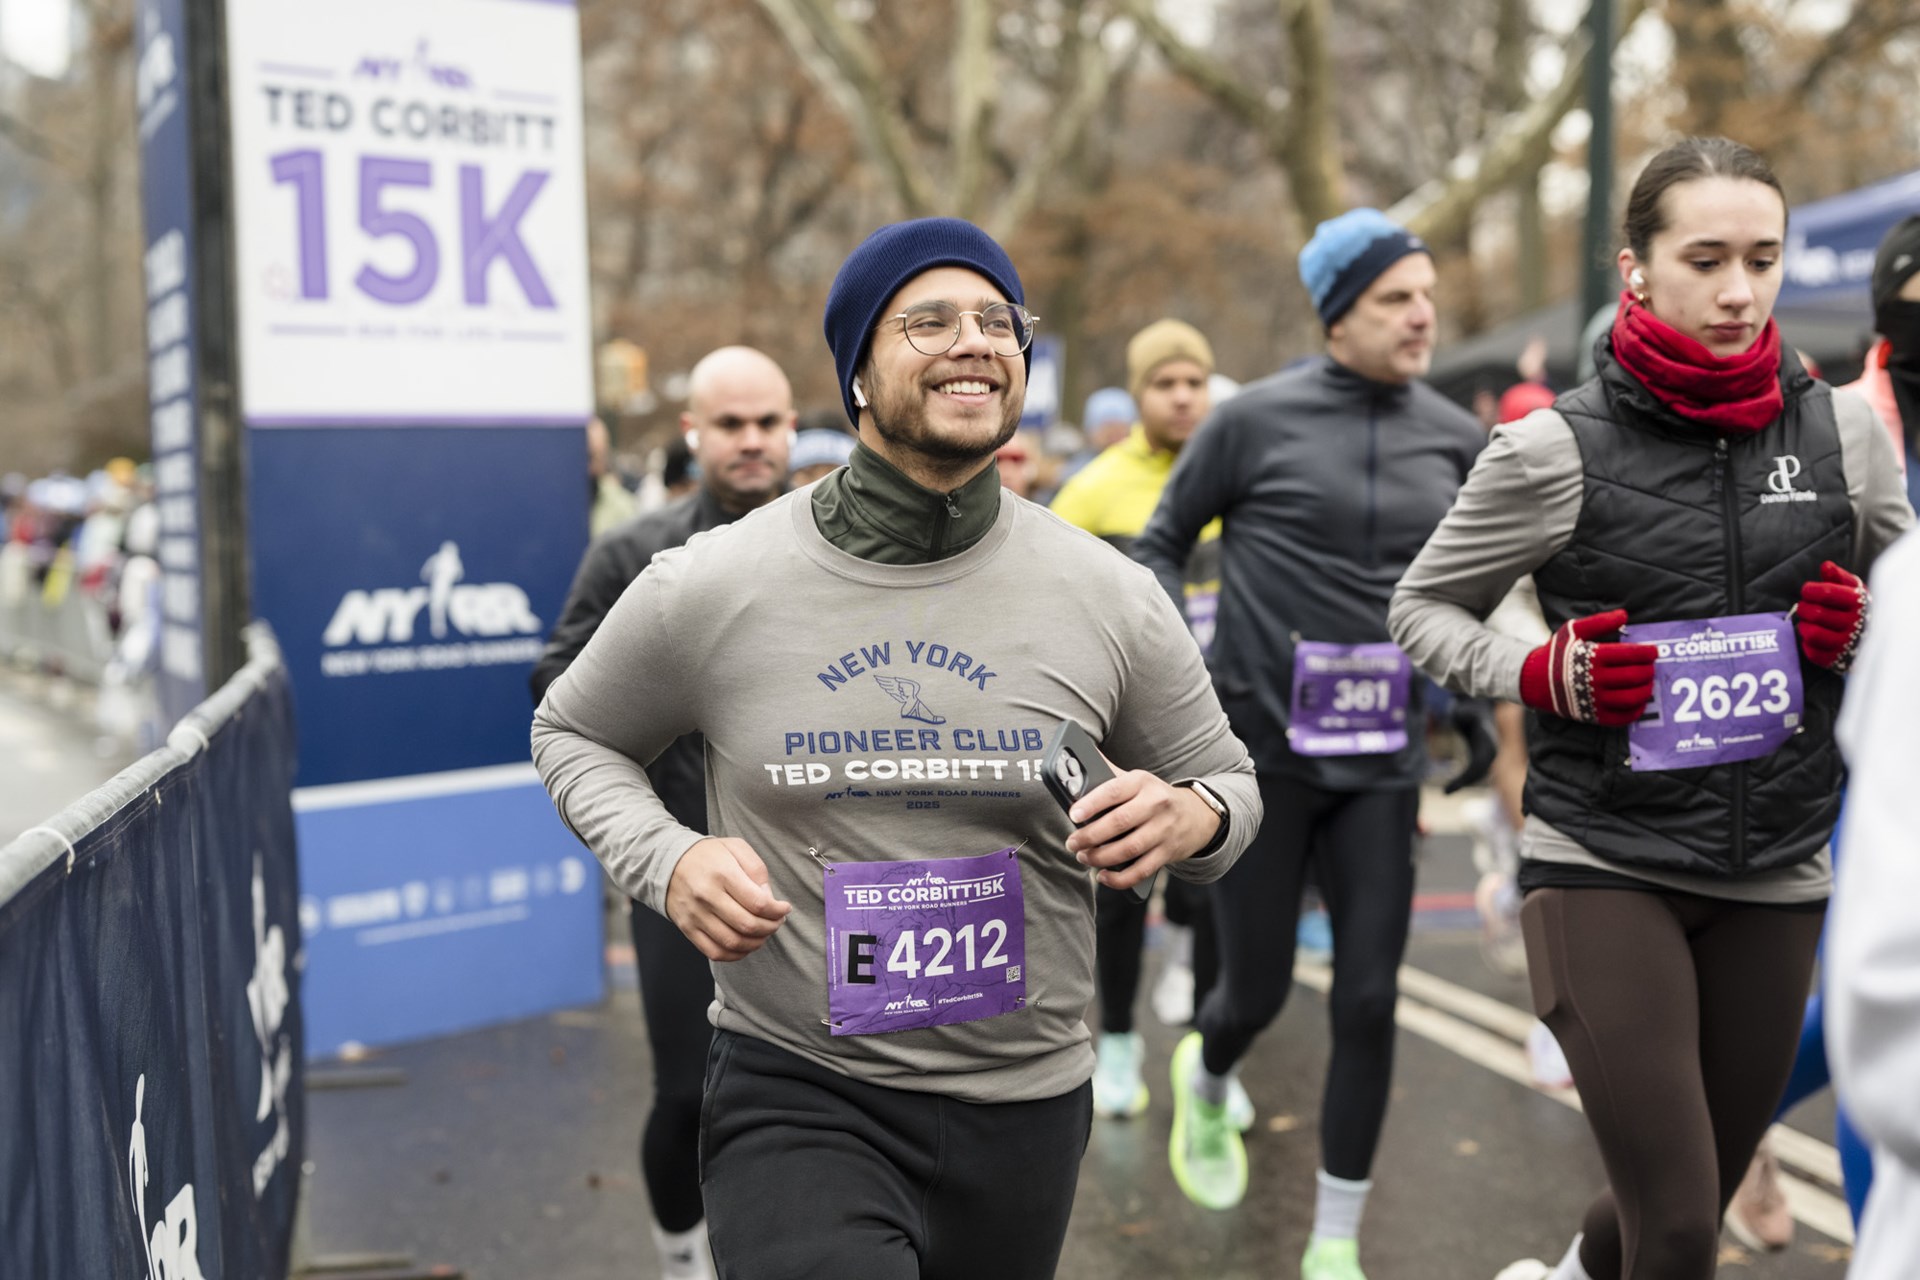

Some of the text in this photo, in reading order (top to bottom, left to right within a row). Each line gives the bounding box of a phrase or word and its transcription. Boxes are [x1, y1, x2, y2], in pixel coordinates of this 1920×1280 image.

[261, 86, 557, 150] TED CORBITT
[268, 148, 558, 311] 15K
[817, 640, 998, 692] NEW YORK
[1670, 669, 1791, 723] 2623
[785, 728, 1044, 756] PIONEER CLUB
[764, 758, 1044, 786] TED CORBITT 15
[876, 790, 901, 798] NEW
[971, 790, 1022, 799] RUNNERS
[906, 800, 941, 810] 2025
[844, 888, 883, 905] TED
[939, 900, 968, 908] RUNNERS
[847, 933, 877, 985] E
[886, 918, 1009, 980] 4212
